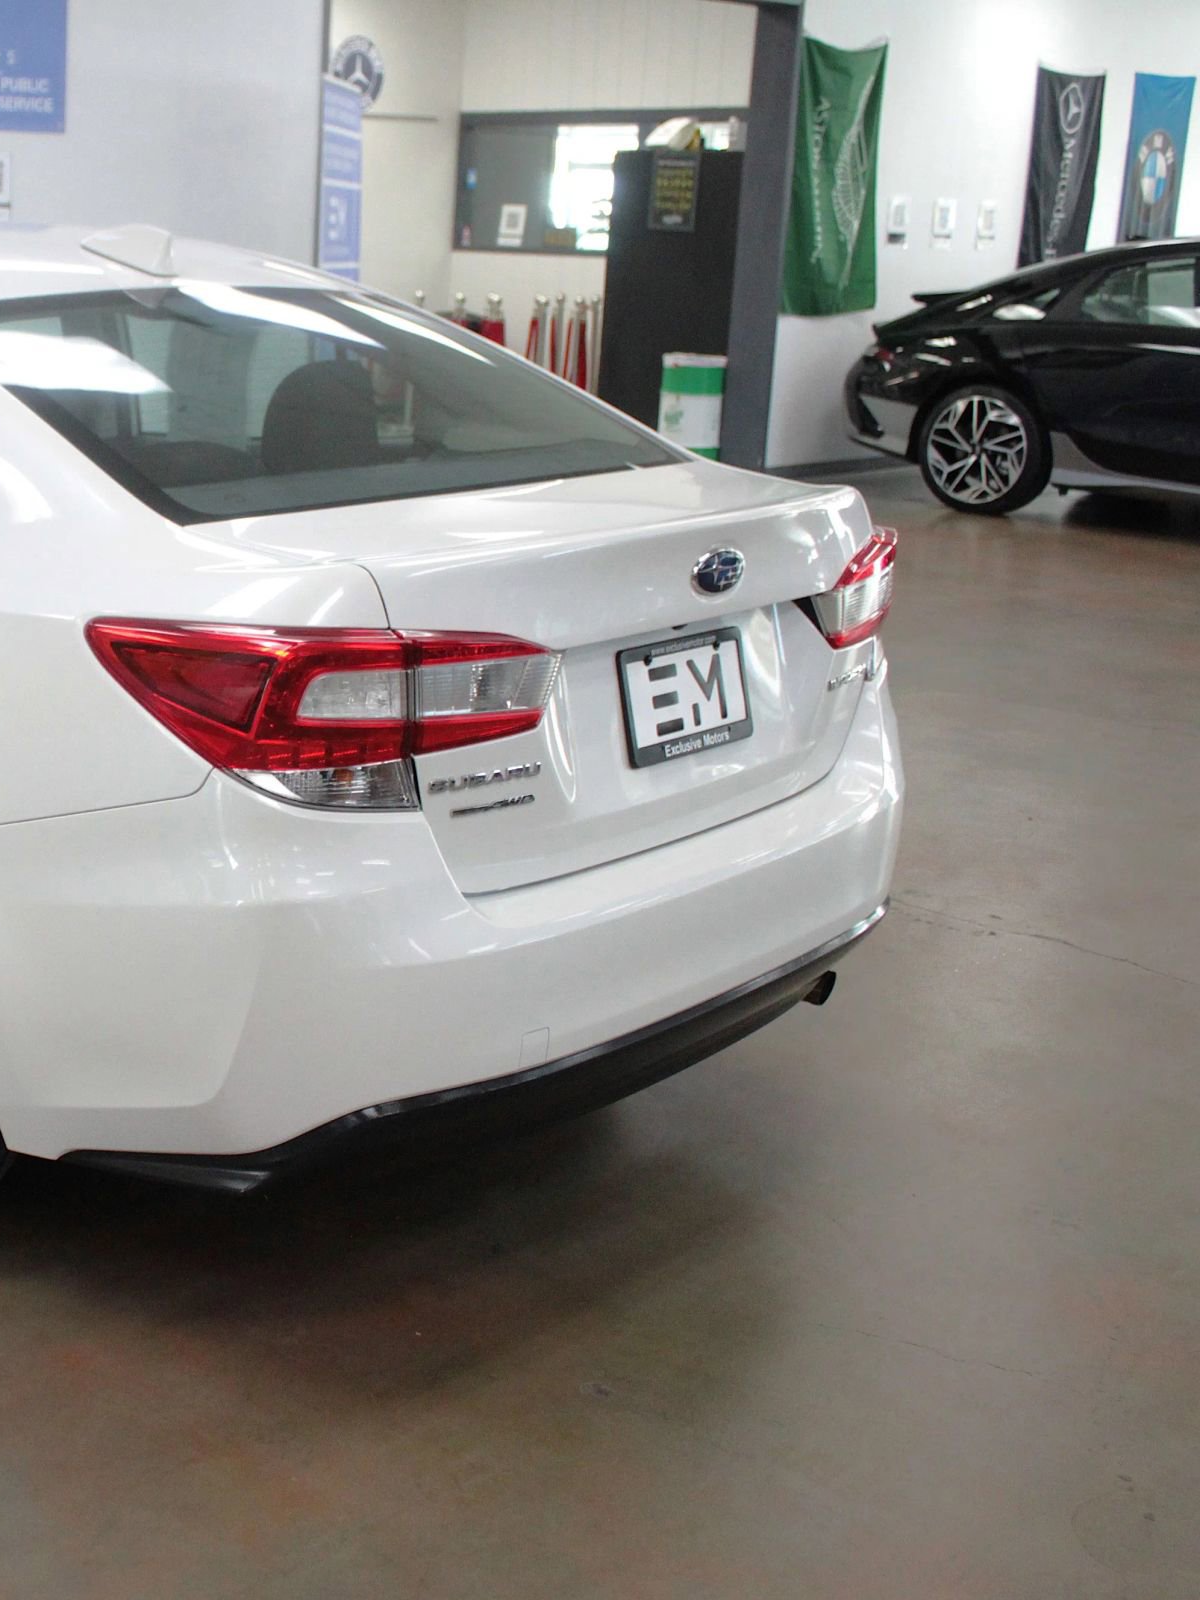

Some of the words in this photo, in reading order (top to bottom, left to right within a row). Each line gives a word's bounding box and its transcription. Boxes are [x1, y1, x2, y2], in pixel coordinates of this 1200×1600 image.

[0, 76, 49, 93] PUBLIC
[647, 653, 728, 737] EM
[664, 739, 702, 757] Exclusive
[702, 730, 730, 746] Motors
[427, 762, 542, 794] SUBARU
